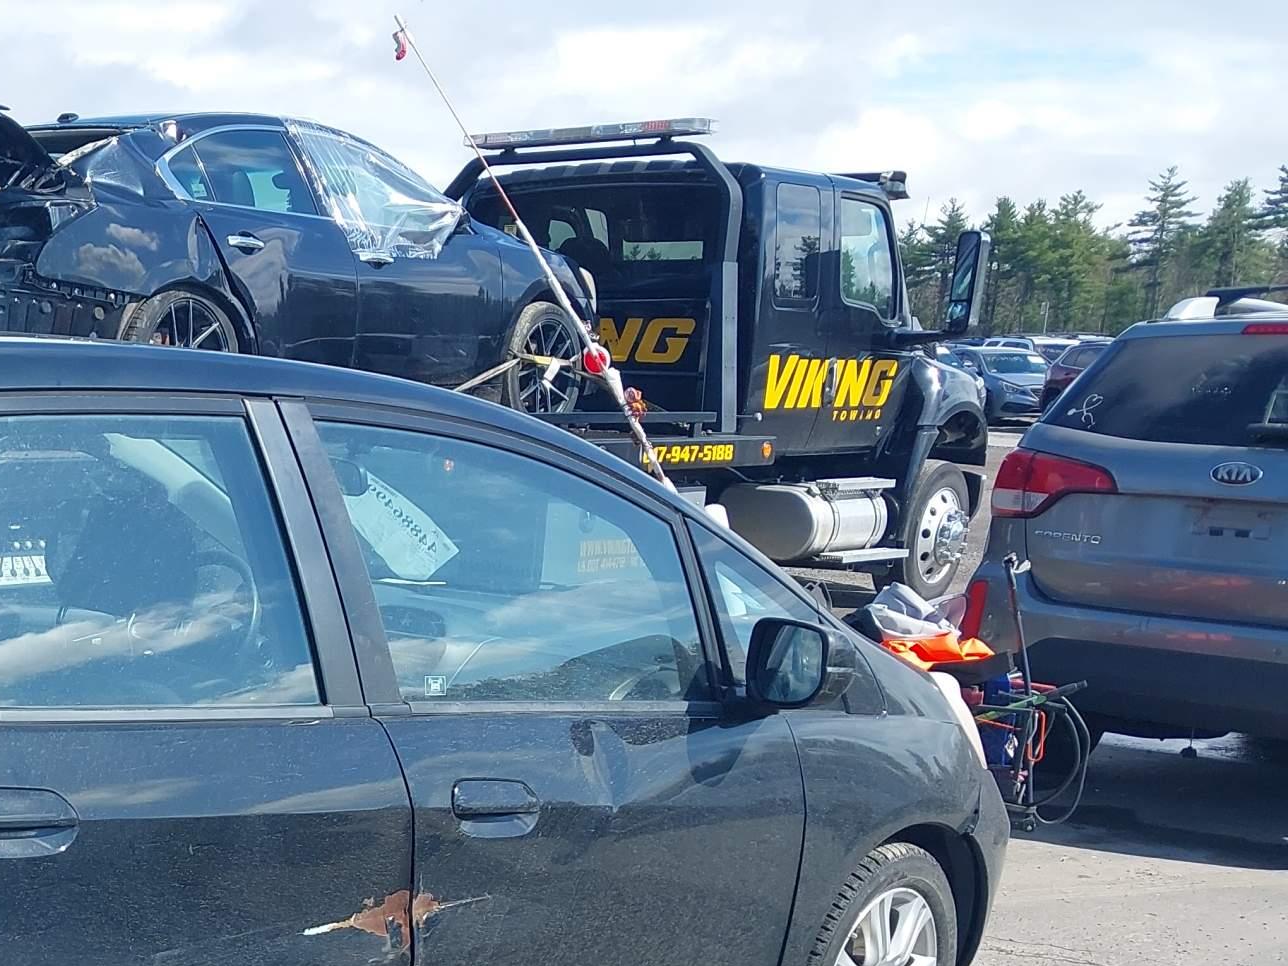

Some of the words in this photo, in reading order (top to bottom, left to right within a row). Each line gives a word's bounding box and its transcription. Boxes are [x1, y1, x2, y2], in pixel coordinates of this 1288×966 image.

[599, 318, 696, 363] NG
[764, 354, 898, 409] VIKING
[832, 409, 881, 421] TOWING
[1215, 466, 1253, 482] KIA
